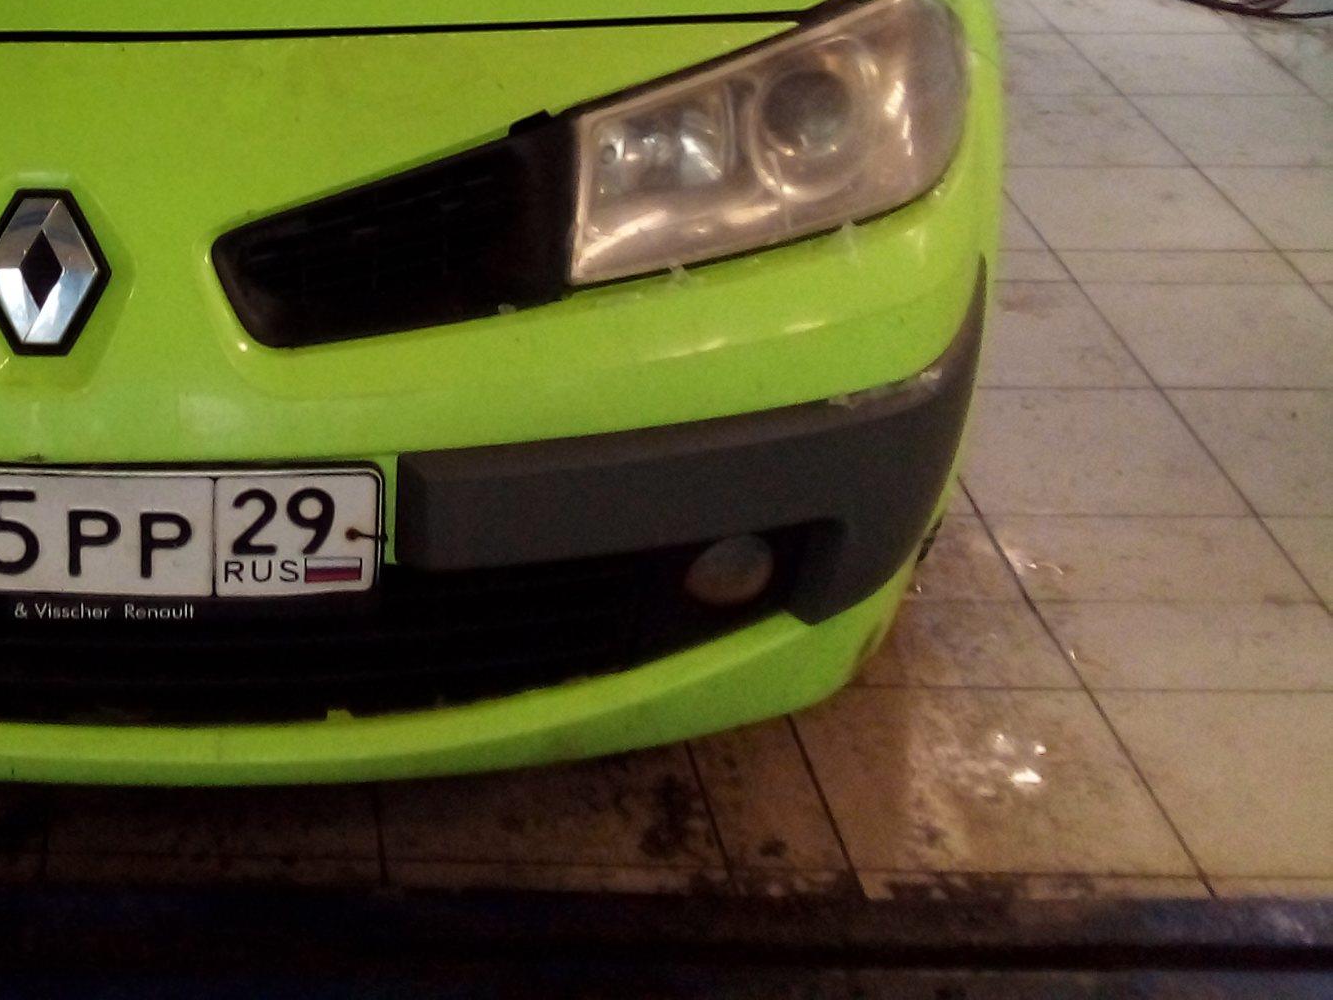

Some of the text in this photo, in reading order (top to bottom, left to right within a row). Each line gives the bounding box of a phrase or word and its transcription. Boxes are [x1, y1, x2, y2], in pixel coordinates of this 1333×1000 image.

[232, 487, 336, 556] 29
[224, 559, 300, 583] RUS
[124, 602, 195, 619] Renault
